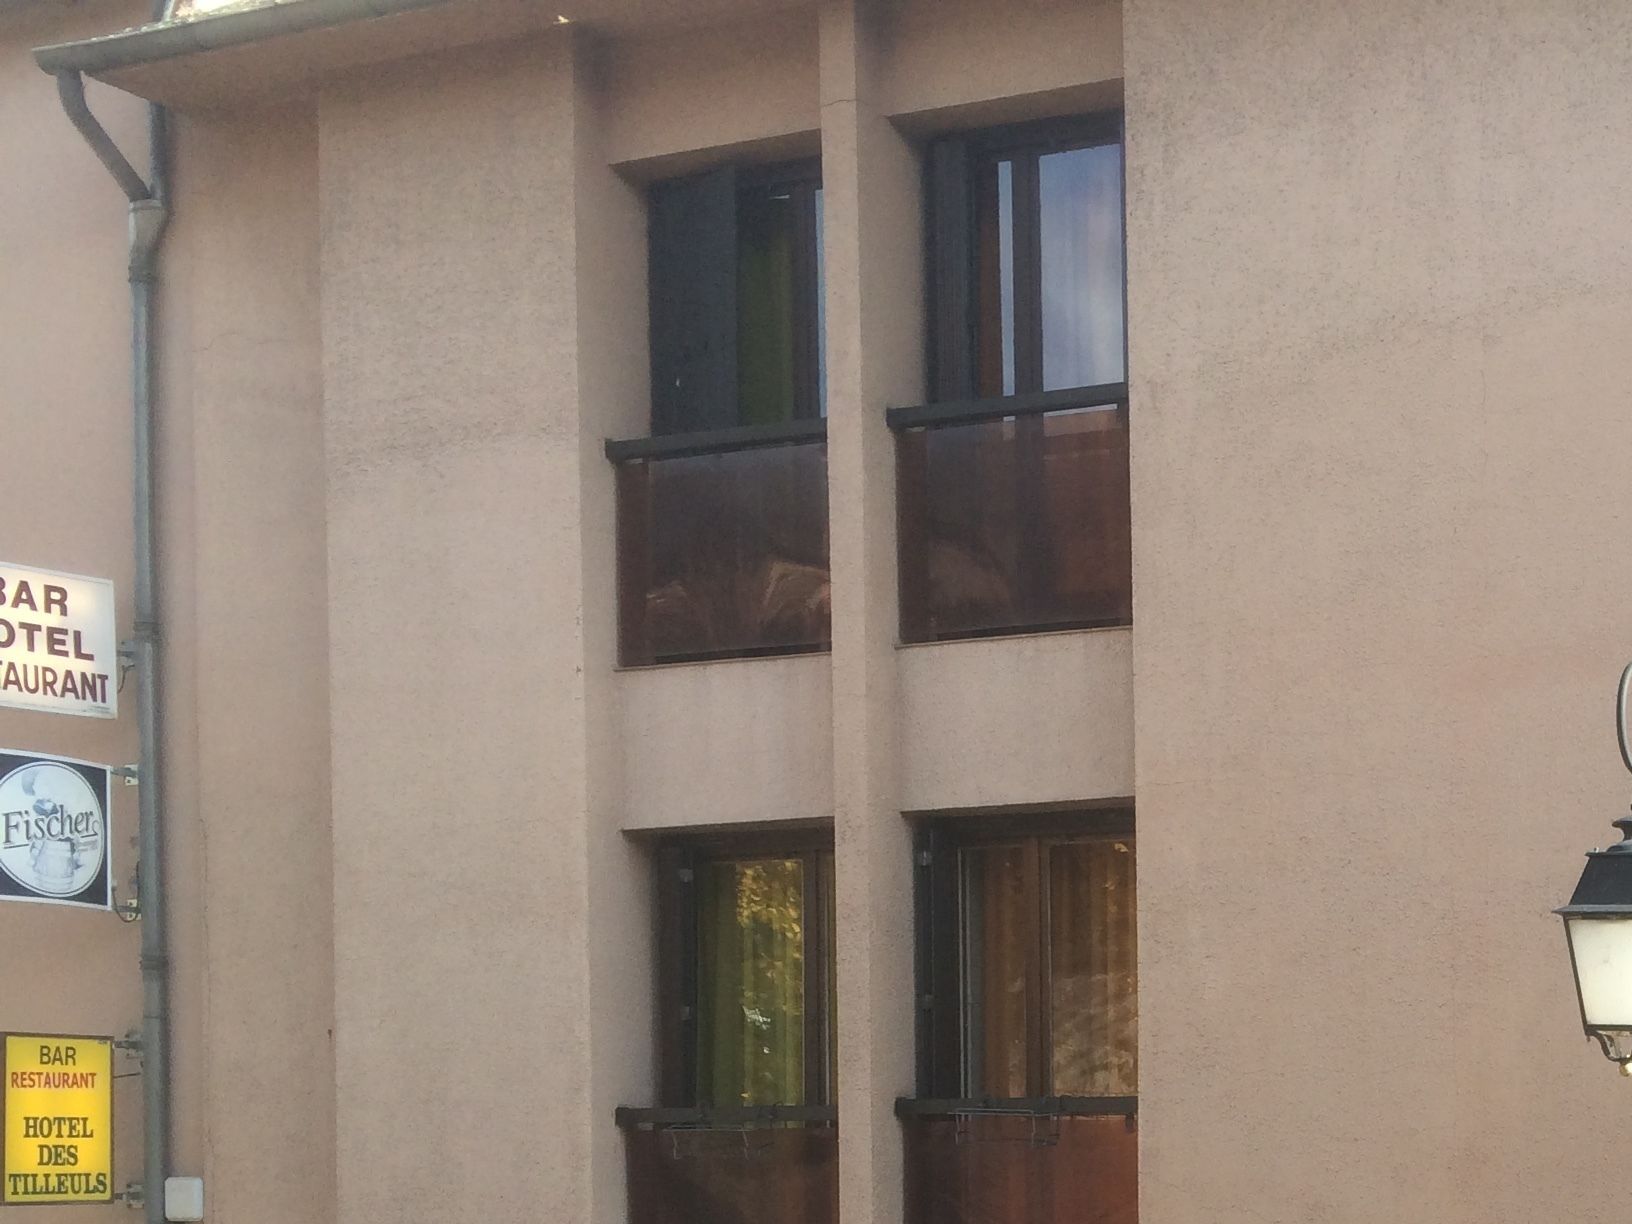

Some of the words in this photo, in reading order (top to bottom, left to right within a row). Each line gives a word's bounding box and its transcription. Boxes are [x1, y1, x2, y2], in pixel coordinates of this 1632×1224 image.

[0, 577, 68, 616] AR
[0, 618, 94, 661] OTEL
[0, 661, 108, 704] AURANT
[2, 804, 95, 845] Fischer
[39, 1045, 76, 1066] BAR
[11, 1072, 97, 1089] RESTAURANT
[23, 1117, 94, 1138] HOTEL
[37, 1144, 78, 1166] DES
[9, 1173, 107, 1195] TILLEULS
